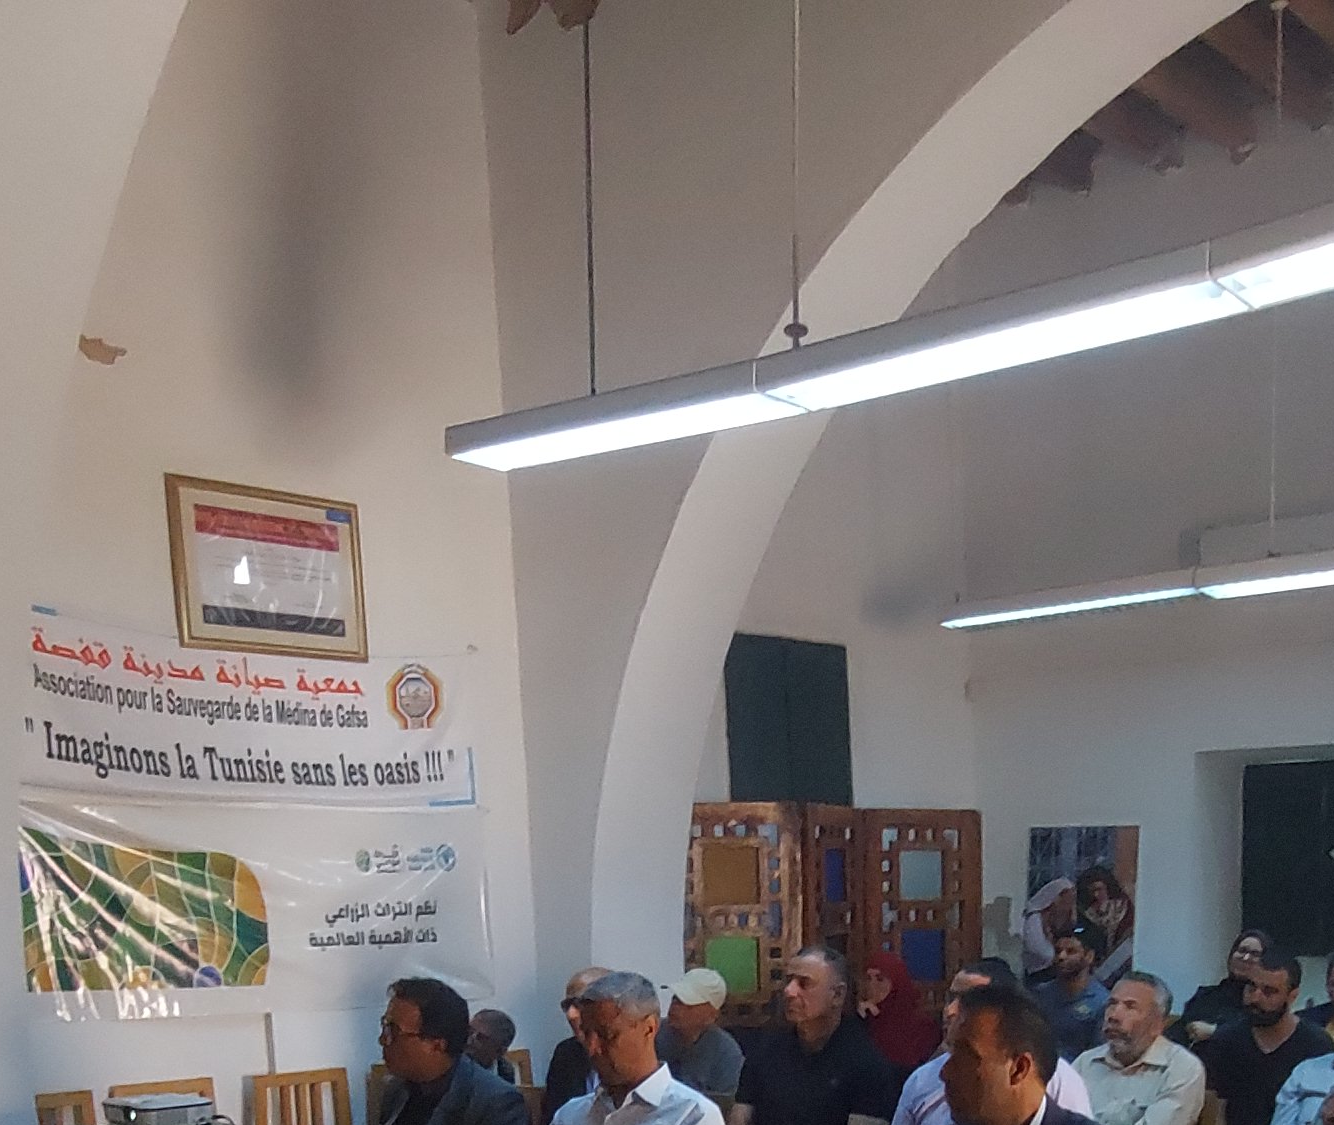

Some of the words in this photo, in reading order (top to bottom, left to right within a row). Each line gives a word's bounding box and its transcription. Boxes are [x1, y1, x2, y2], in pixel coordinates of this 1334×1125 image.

[31, 626, 113, 670] قفصة
[123, 645, 205, 684] مدينة
[33, 663, 113, 705] Association
[117, 687, 148, 714] pour
[151, 687, 164, 714] la
[167, 688, 242, 725] Sauvegarde
[244, 699, 259, 722] de
[262, 698, 273, 724] la
[274, 700, 317, 728] Médina
[319, 703, 334, 728] de
[336, 706, 369, 728] Gafsa
[216, 656, 286, 695] صيانة
[296, 668, 365, 700] جمعية
[43, 720, 171, 779] Imaginons
[175, 742, 200, 780] la
[203, 746, 286, 784] Tunisie
[291, 757, 337, 787] sans
[339, 753, 369, 787] les
[374, 753, 421, 786] oasis
